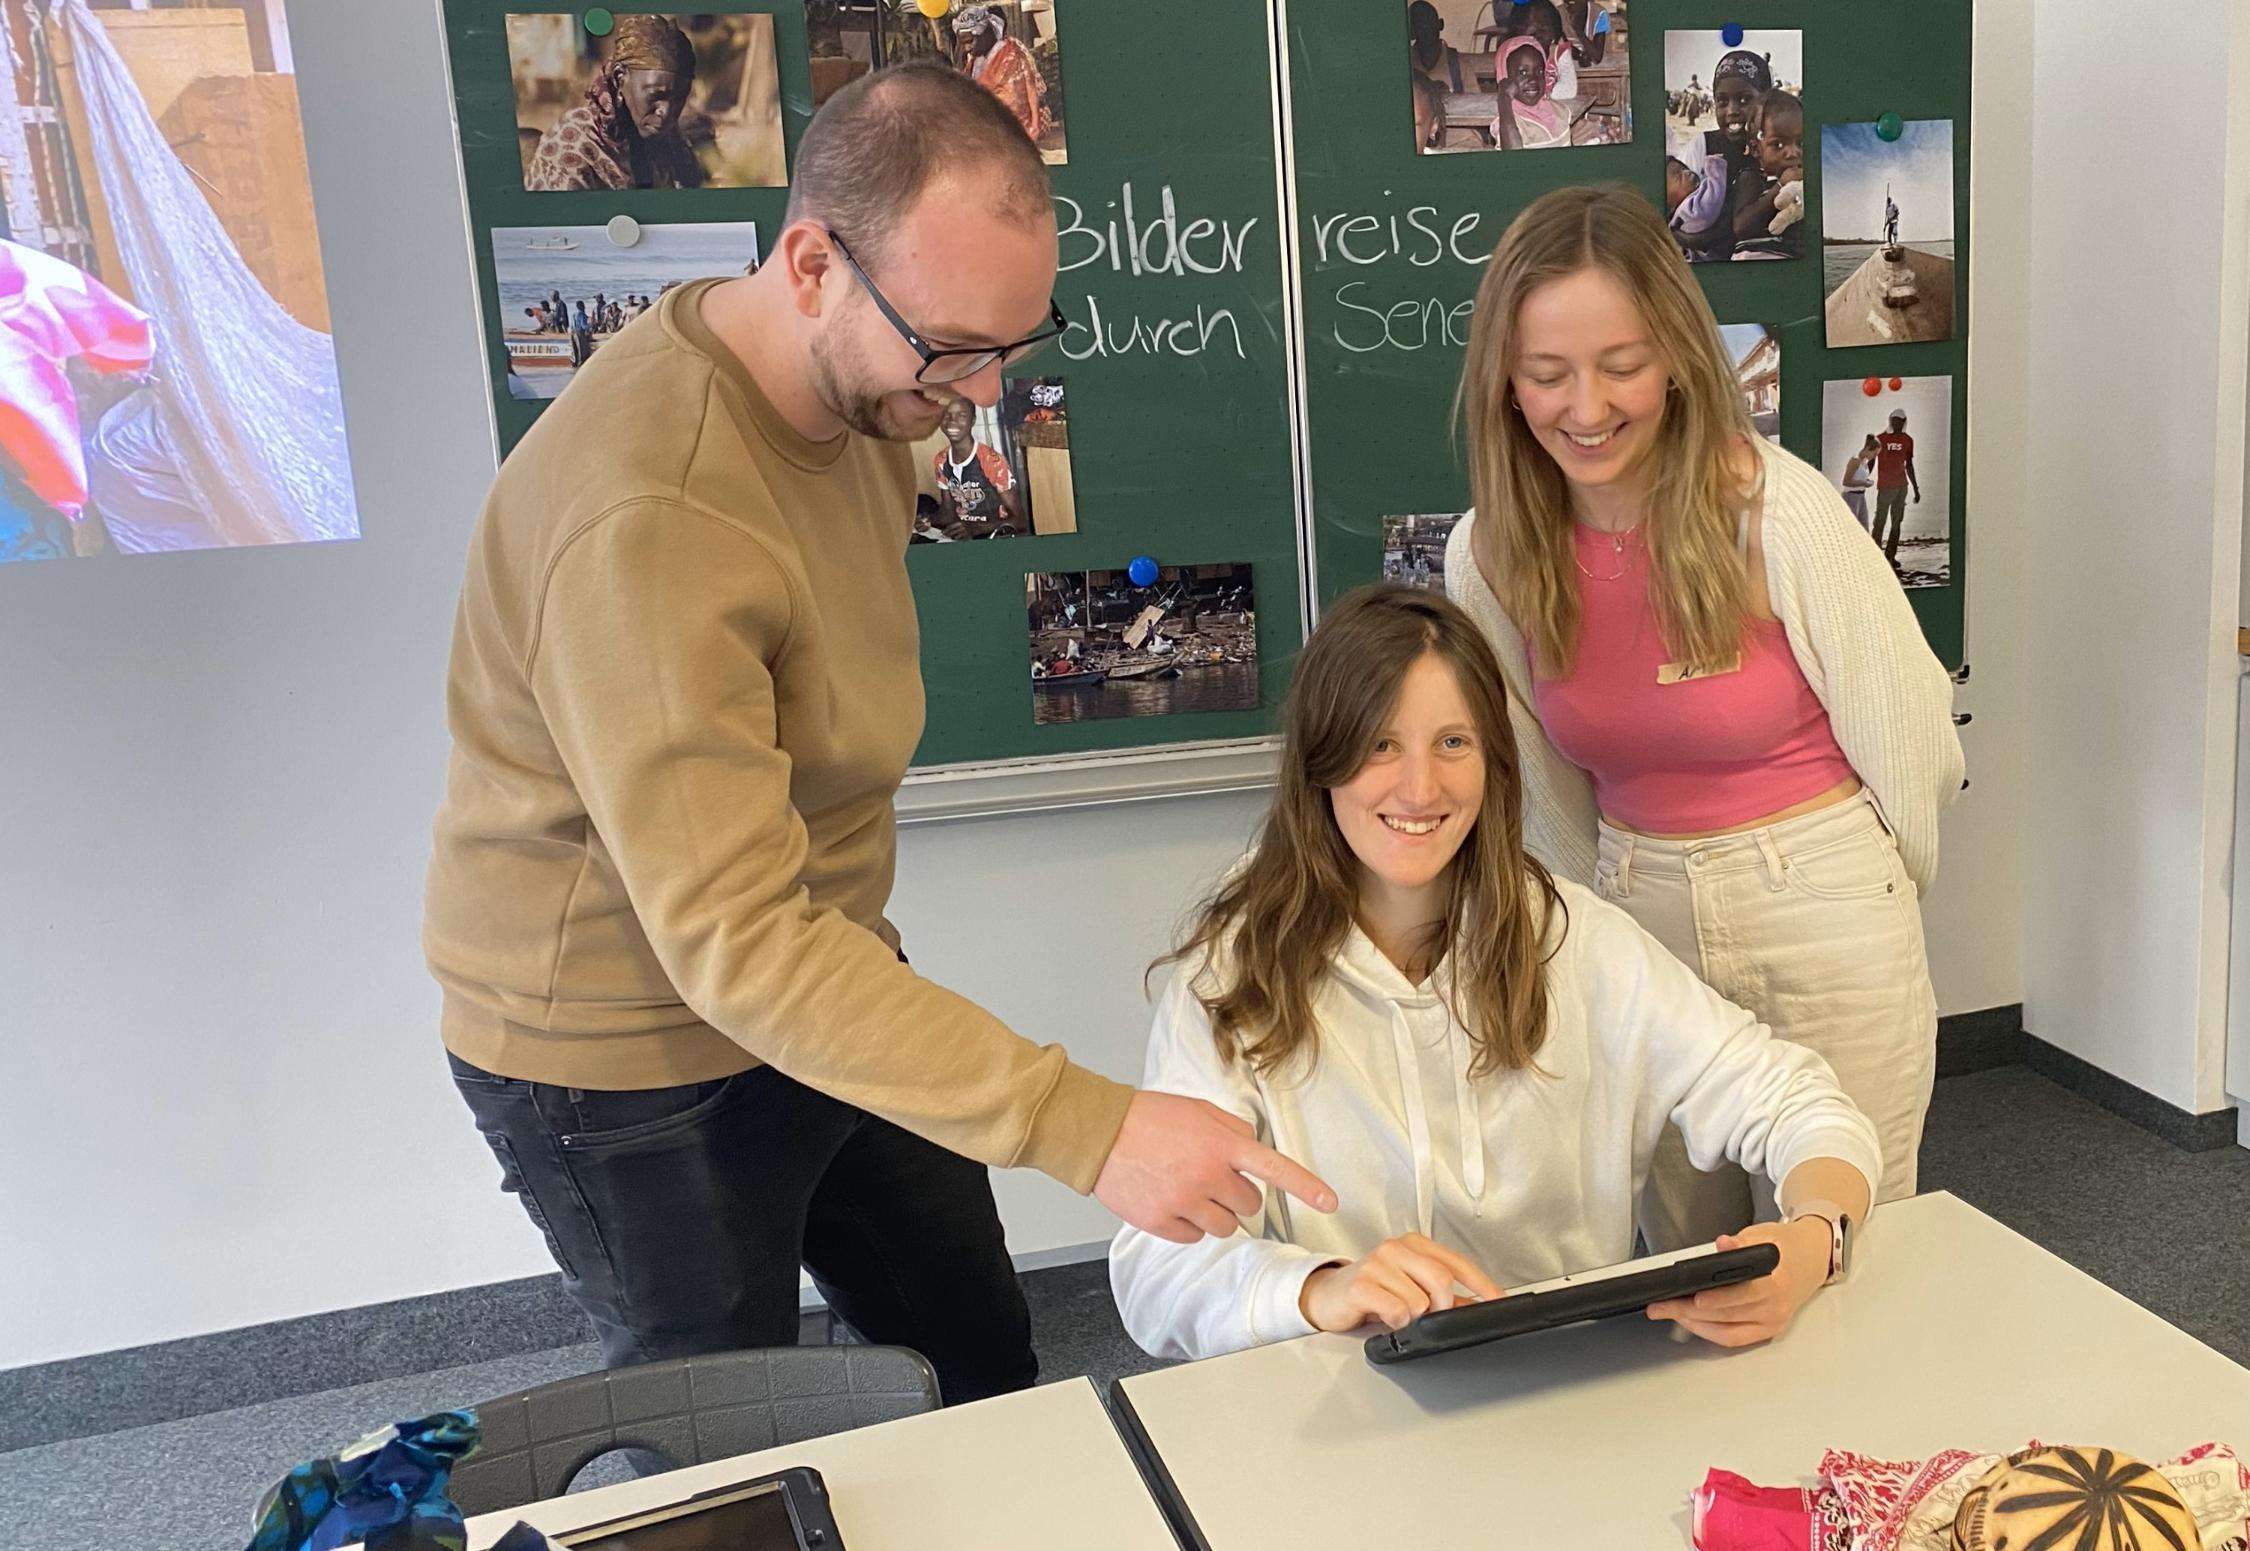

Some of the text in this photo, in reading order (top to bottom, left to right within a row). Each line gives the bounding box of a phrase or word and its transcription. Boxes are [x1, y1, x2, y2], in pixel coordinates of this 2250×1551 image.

[1051, 182, 1493, 276] Bilder reise
[1059, 281, 1475, 360] durch Sene
[1886, 442, 1903, 451] YES
